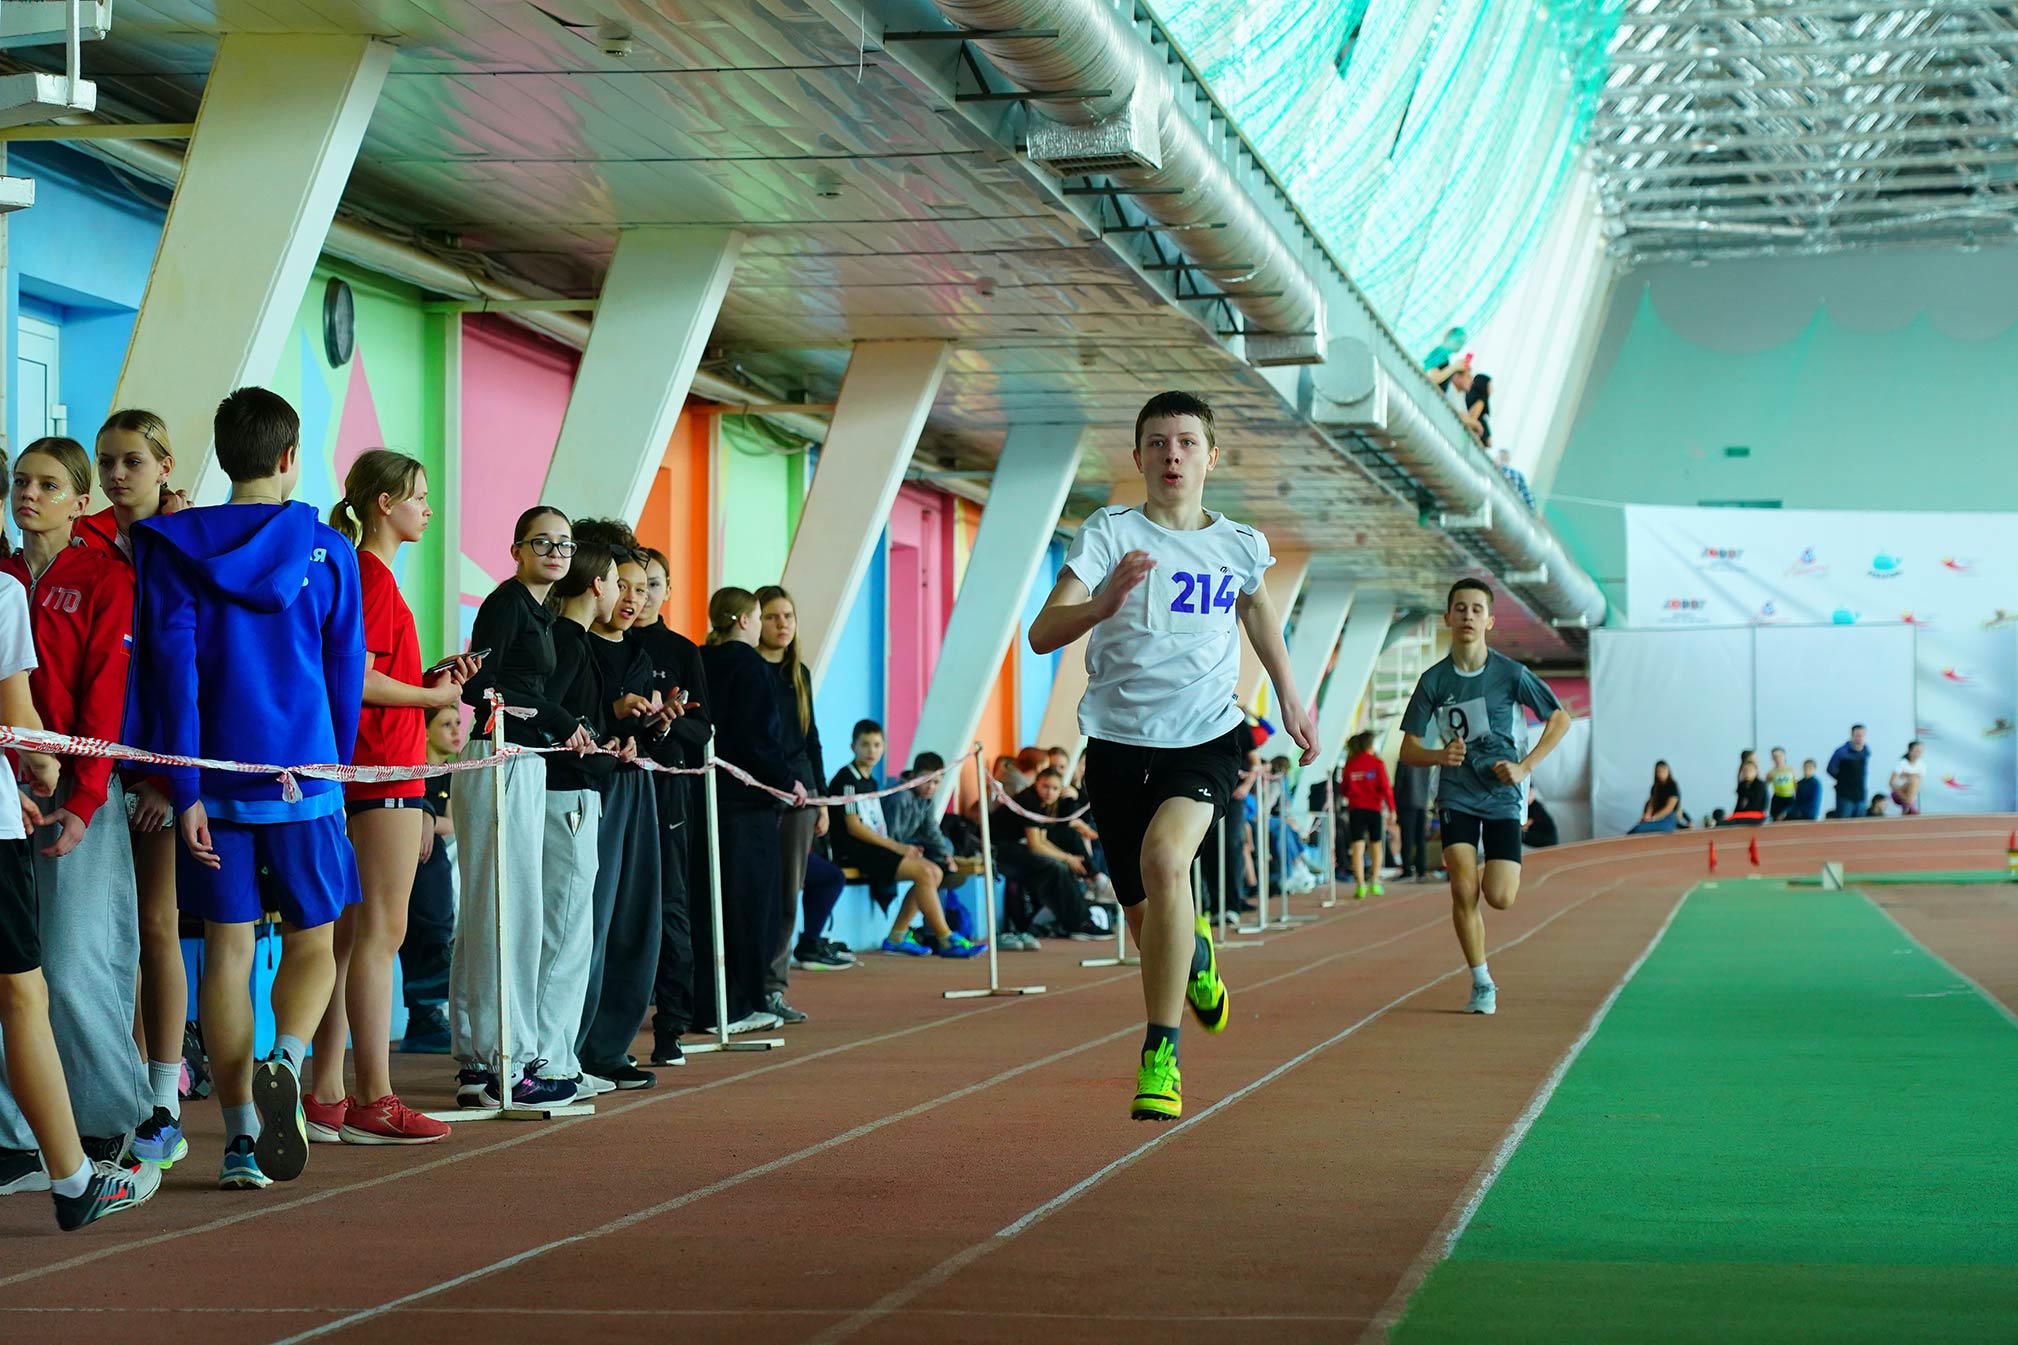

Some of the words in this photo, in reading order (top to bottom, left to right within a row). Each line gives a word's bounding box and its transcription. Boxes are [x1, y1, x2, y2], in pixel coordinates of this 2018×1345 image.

[310, 548, 327, 562] Я
[42, 586, 82, 613] ГТО
[1171, 572, 1235, 614] 214
[1449, 707, 1469, 740] 9
